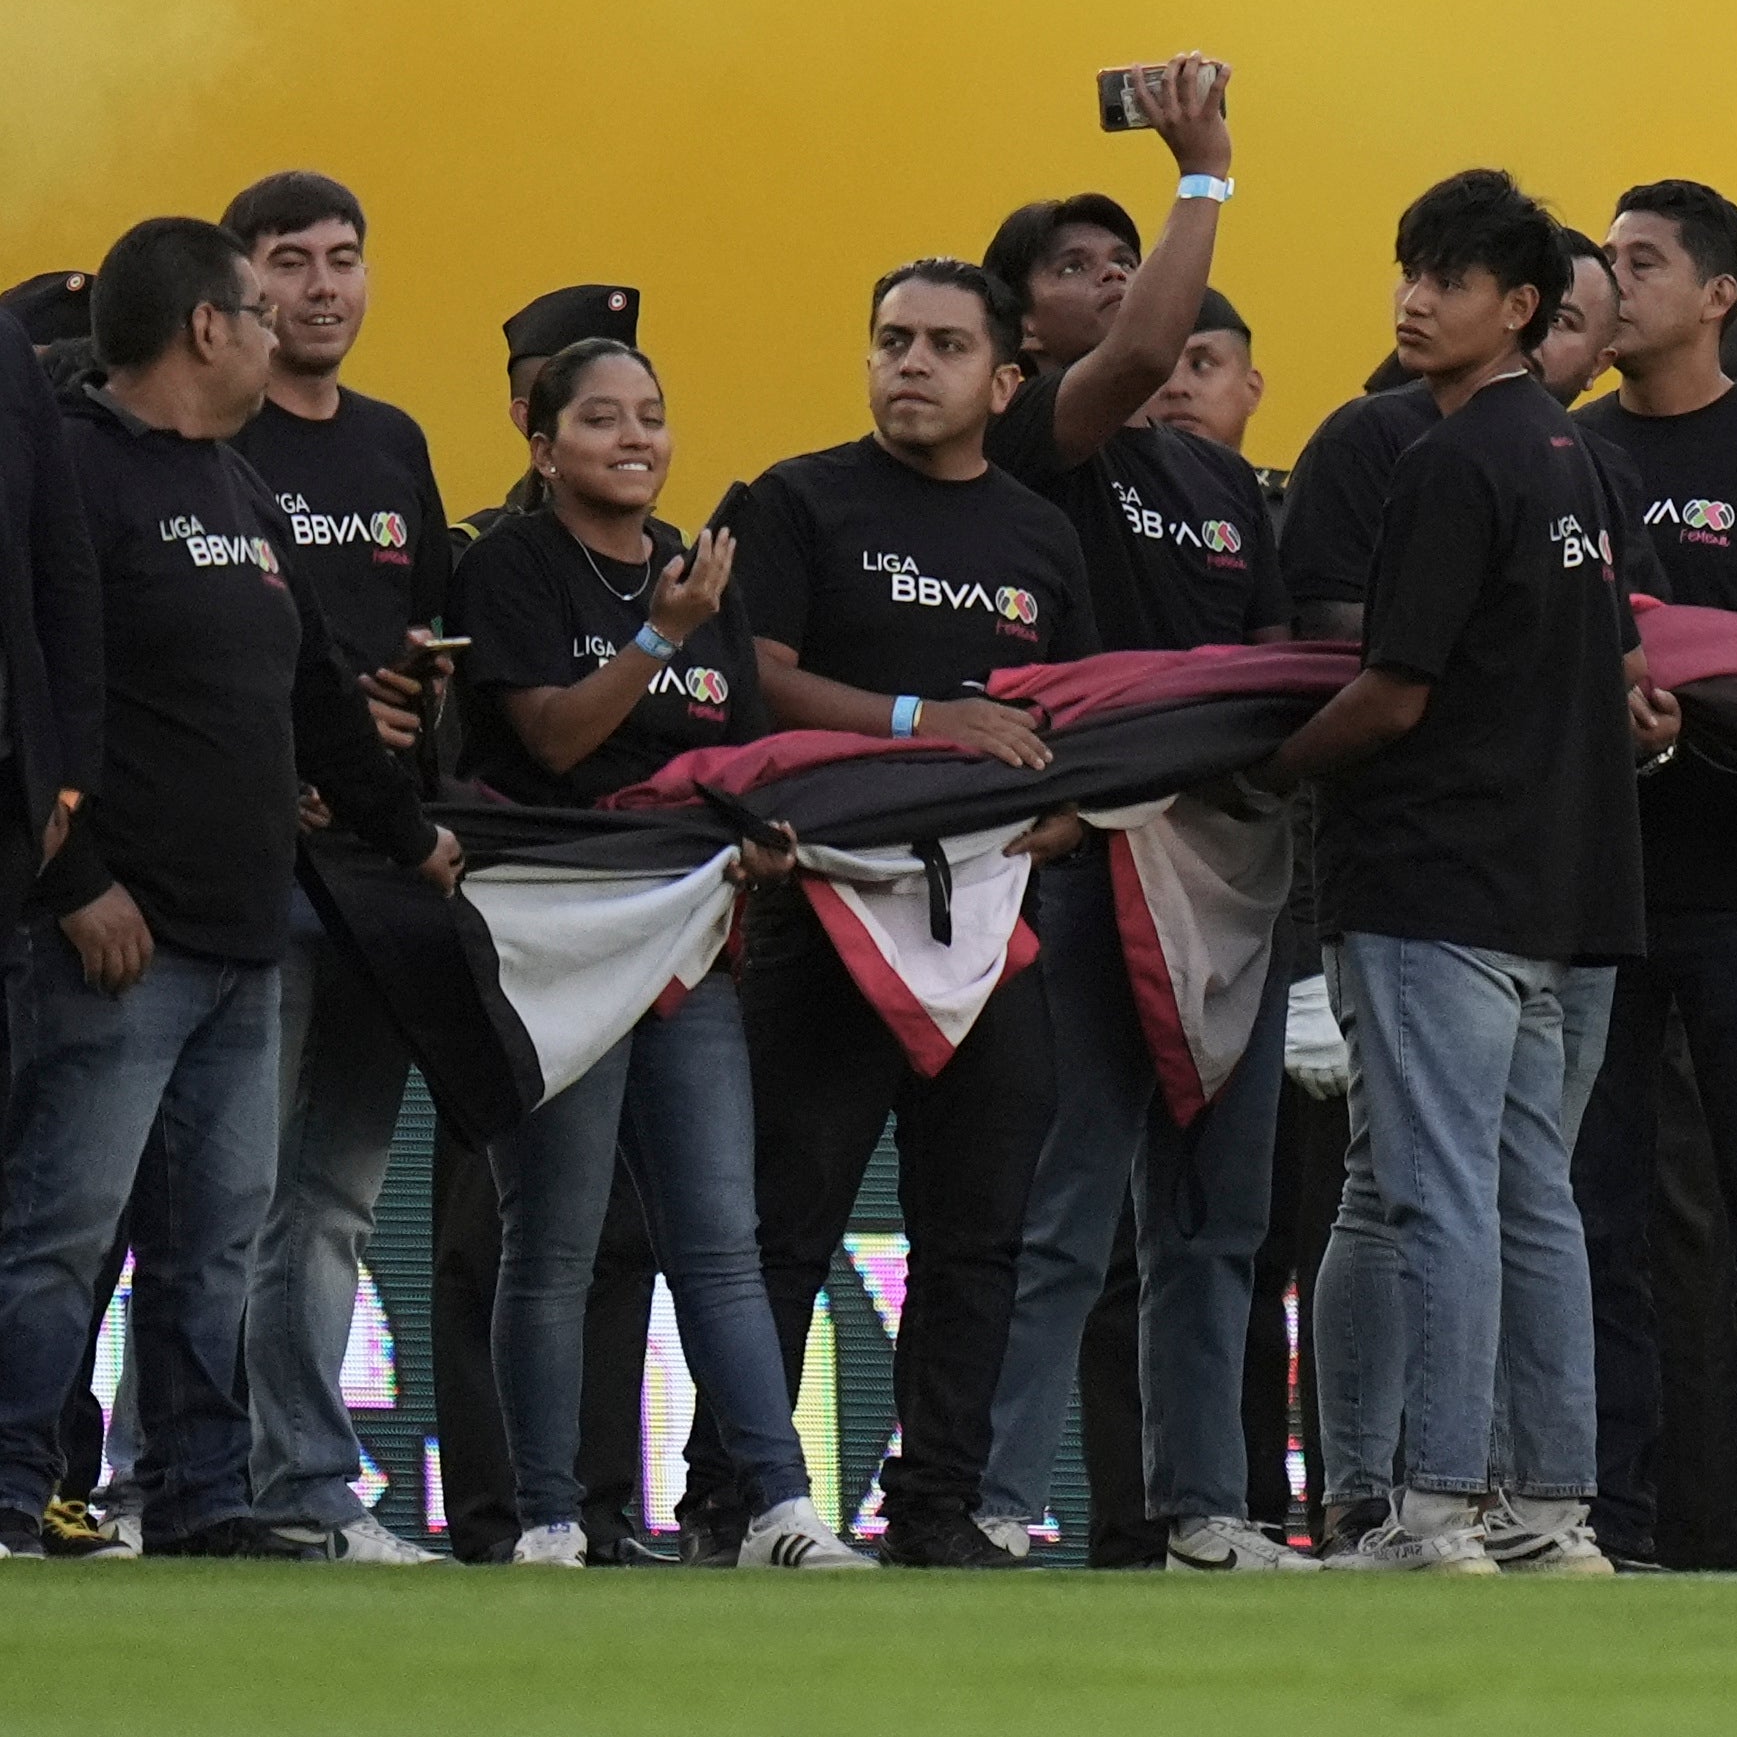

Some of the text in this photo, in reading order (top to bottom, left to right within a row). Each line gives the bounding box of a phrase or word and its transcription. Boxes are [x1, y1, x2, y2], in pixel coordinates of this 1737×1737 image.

[274, 492, 311, 515] GA
[1643, 498, 1681, 525] VA
[159, 514, 206, 542] LIGA
[290, 512, 371, 546] BBVA
[1550, 514, 1583, 542] LIGA
[185, 534, 257, 567] BBVA
[862, 550, 920, 576] LIGA
[891, 573, 995, 613] BBVA
[573, 635, 617, 658] LIGA
